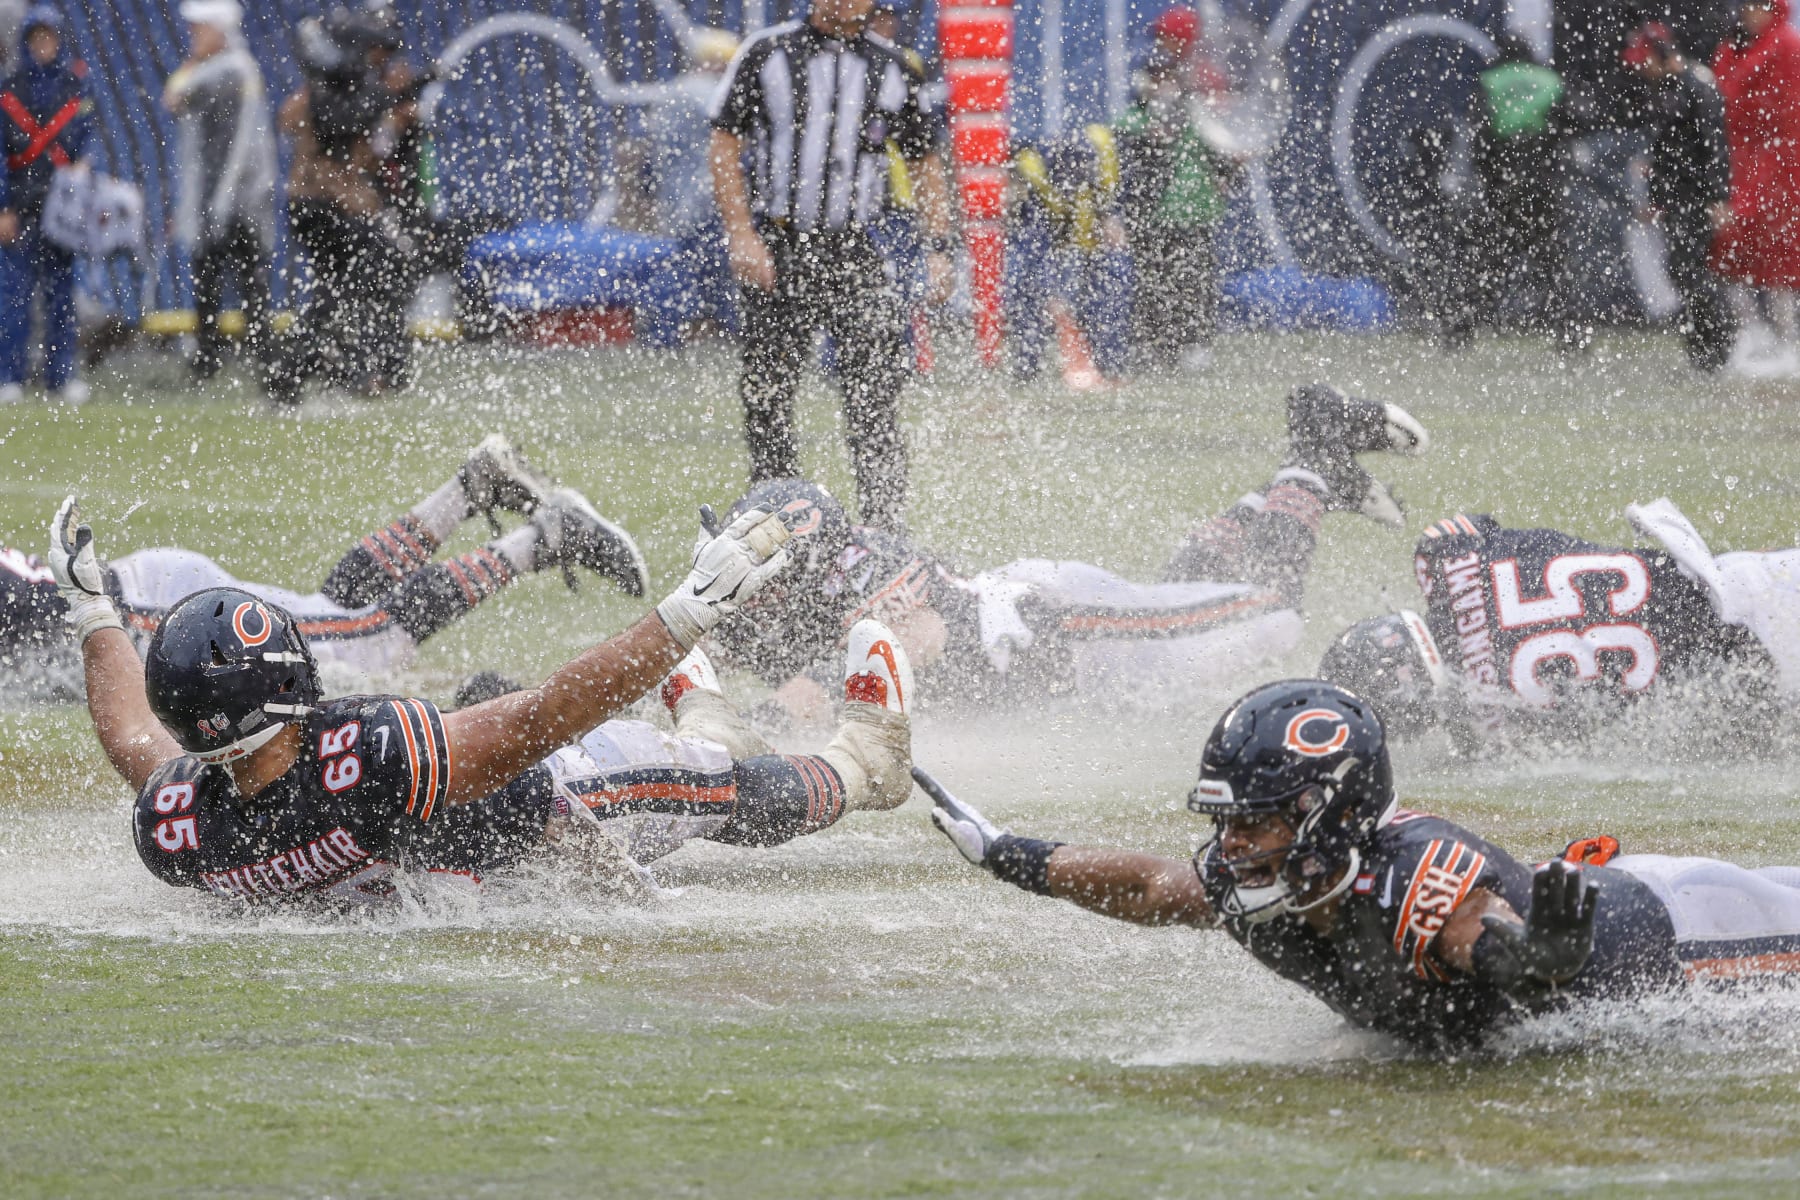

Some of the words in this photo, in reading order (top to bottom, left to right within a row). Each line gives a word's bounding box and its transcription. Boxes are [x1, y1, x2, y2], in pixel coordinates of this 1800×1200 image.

[1489, 551, 1660, 707] 35
[319, 720, 363, 794] 65
[154, 781, 201, 853] 65
[1409, 866, 1466, 938] GSH
